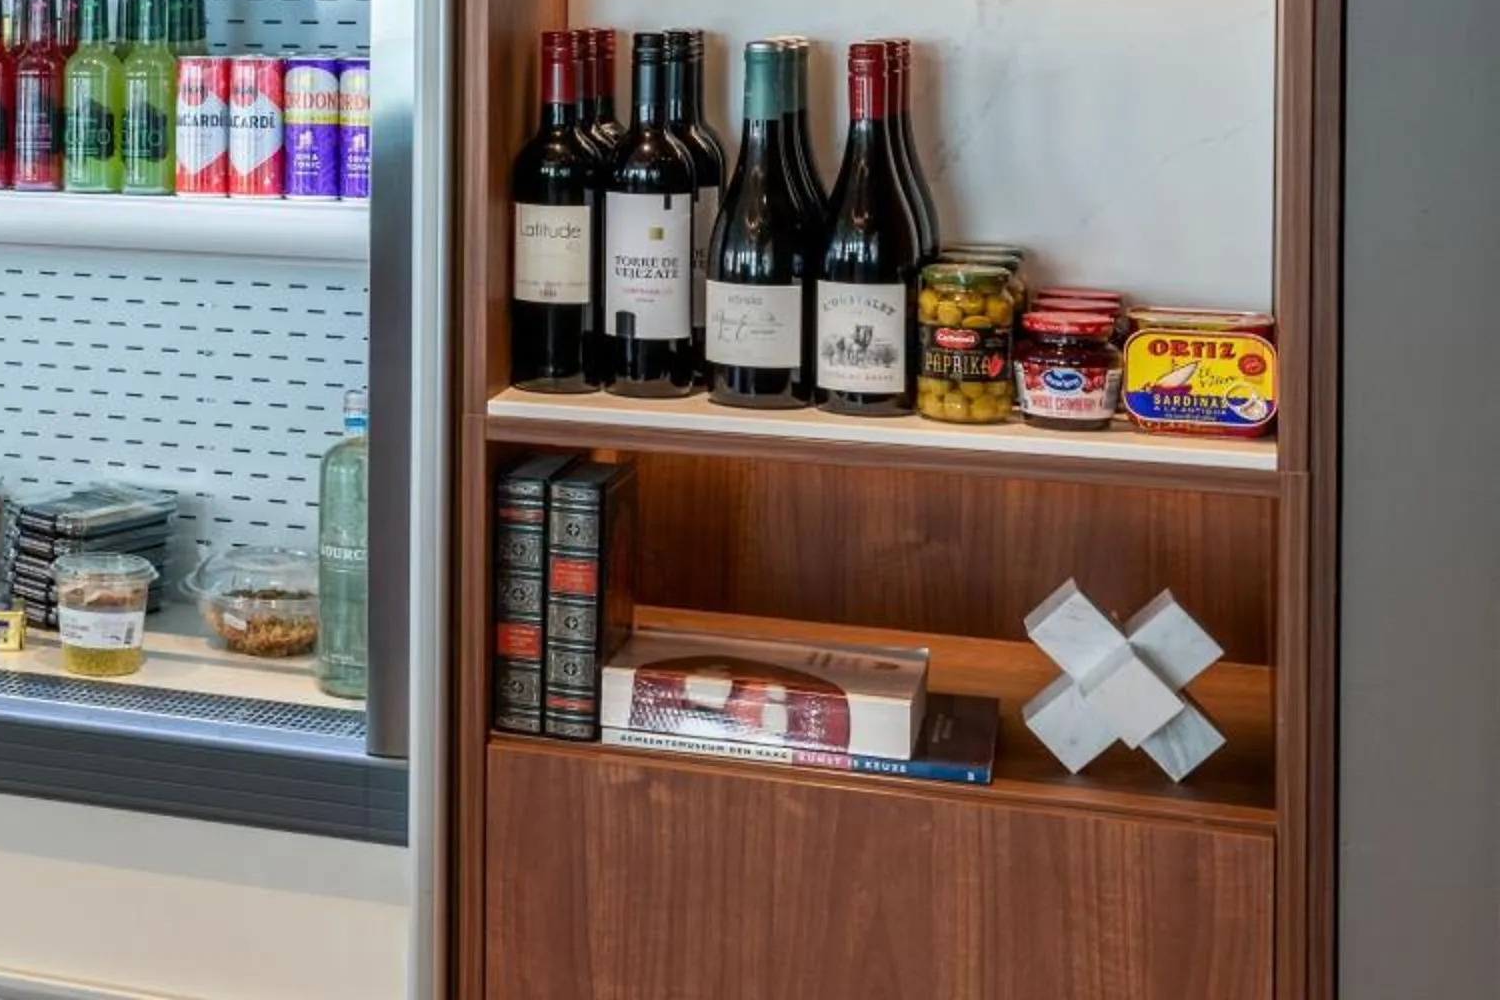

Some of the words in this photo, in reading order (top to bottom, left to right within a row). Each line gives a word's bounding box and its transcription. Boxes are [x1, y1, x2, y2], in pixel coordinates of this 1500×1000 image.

[662, 257, 679, 269] DE
[1148, 339, 1236, 360] ORTIZ
[925, 351, 990, 376] PAPRIKA
[729, 746, 752, 755] DEN
[798, 751, 842, 767] KUNST
[864, 761, 908, 773] KEUZE
